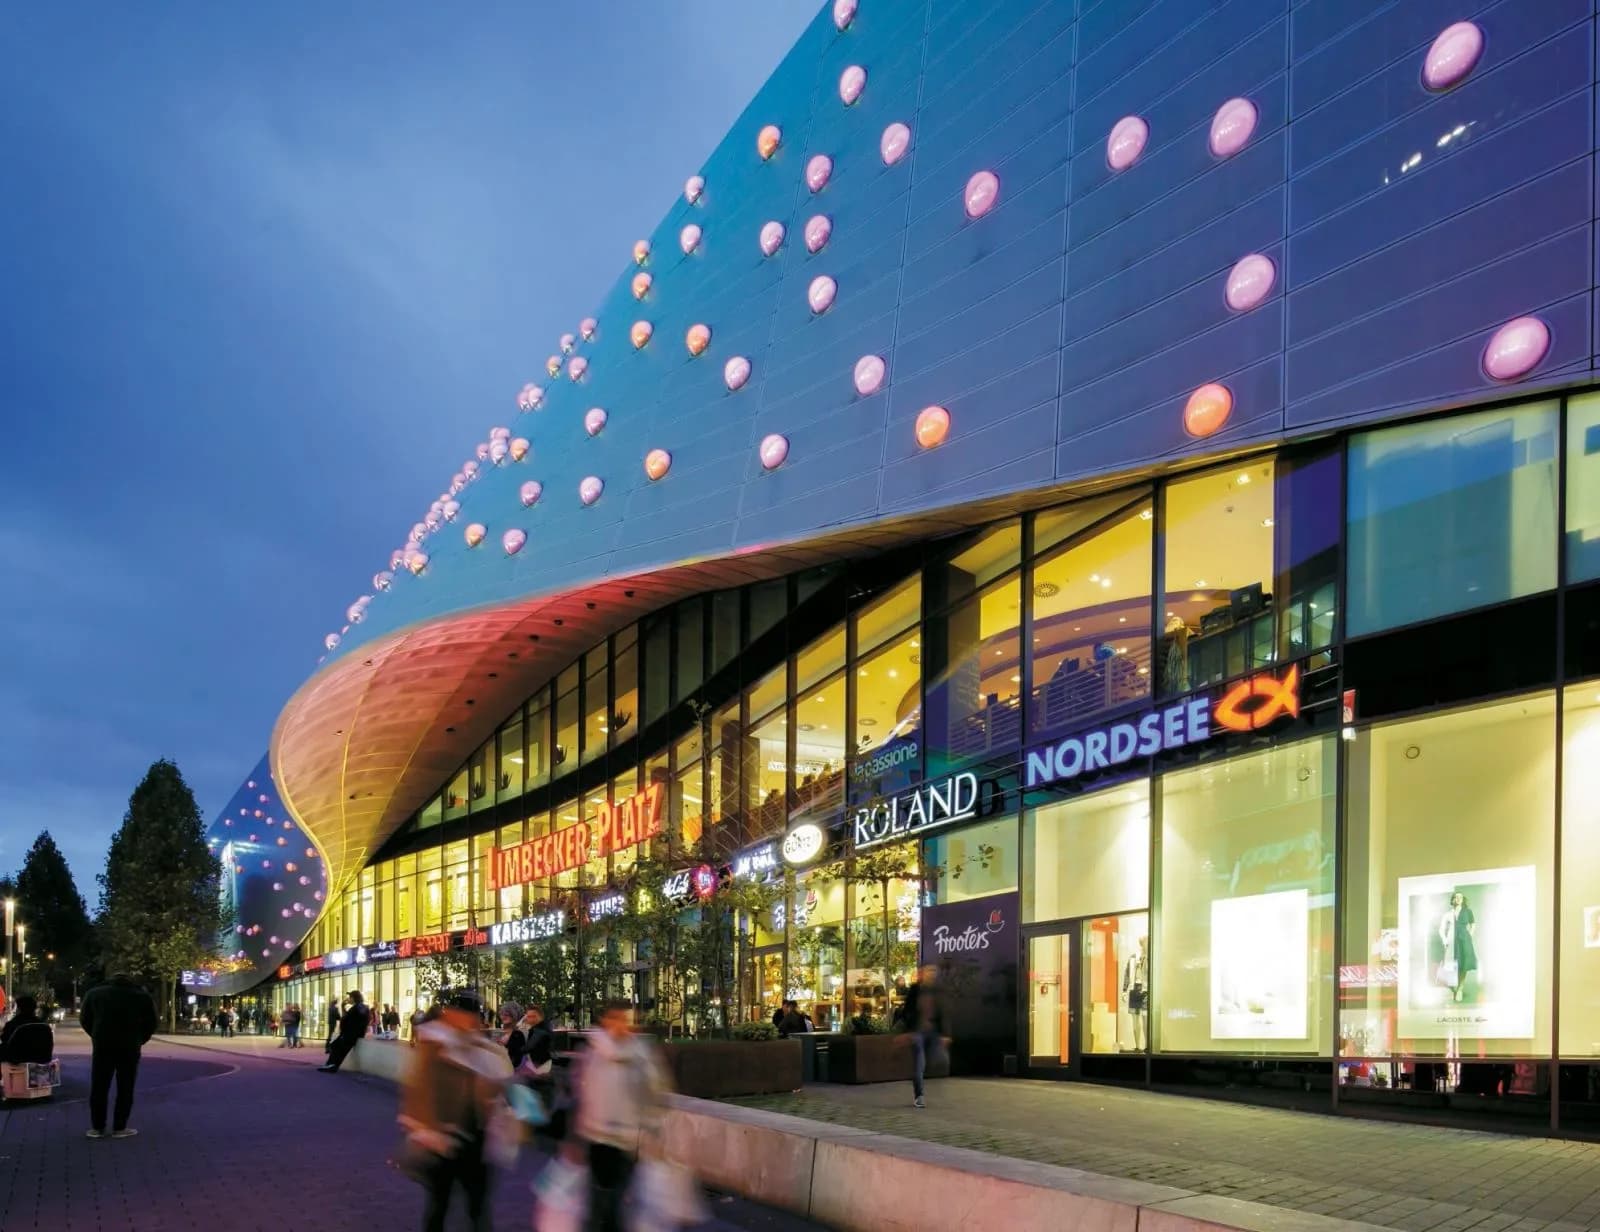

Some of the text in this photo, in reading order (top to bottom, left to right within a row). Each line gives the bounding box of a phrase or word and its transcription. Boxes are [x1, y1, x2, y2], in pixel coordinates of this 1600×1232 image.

[1027, 697, 1210, 786] NORDSEE
[486, 781, 664, 891] LIMBECKER PLATZ
[855, 772, 978, 845] ROLAND
[933, 925, 990, 954] Frooters
[1436, 1016, 1473, 1024] LACOSTE
